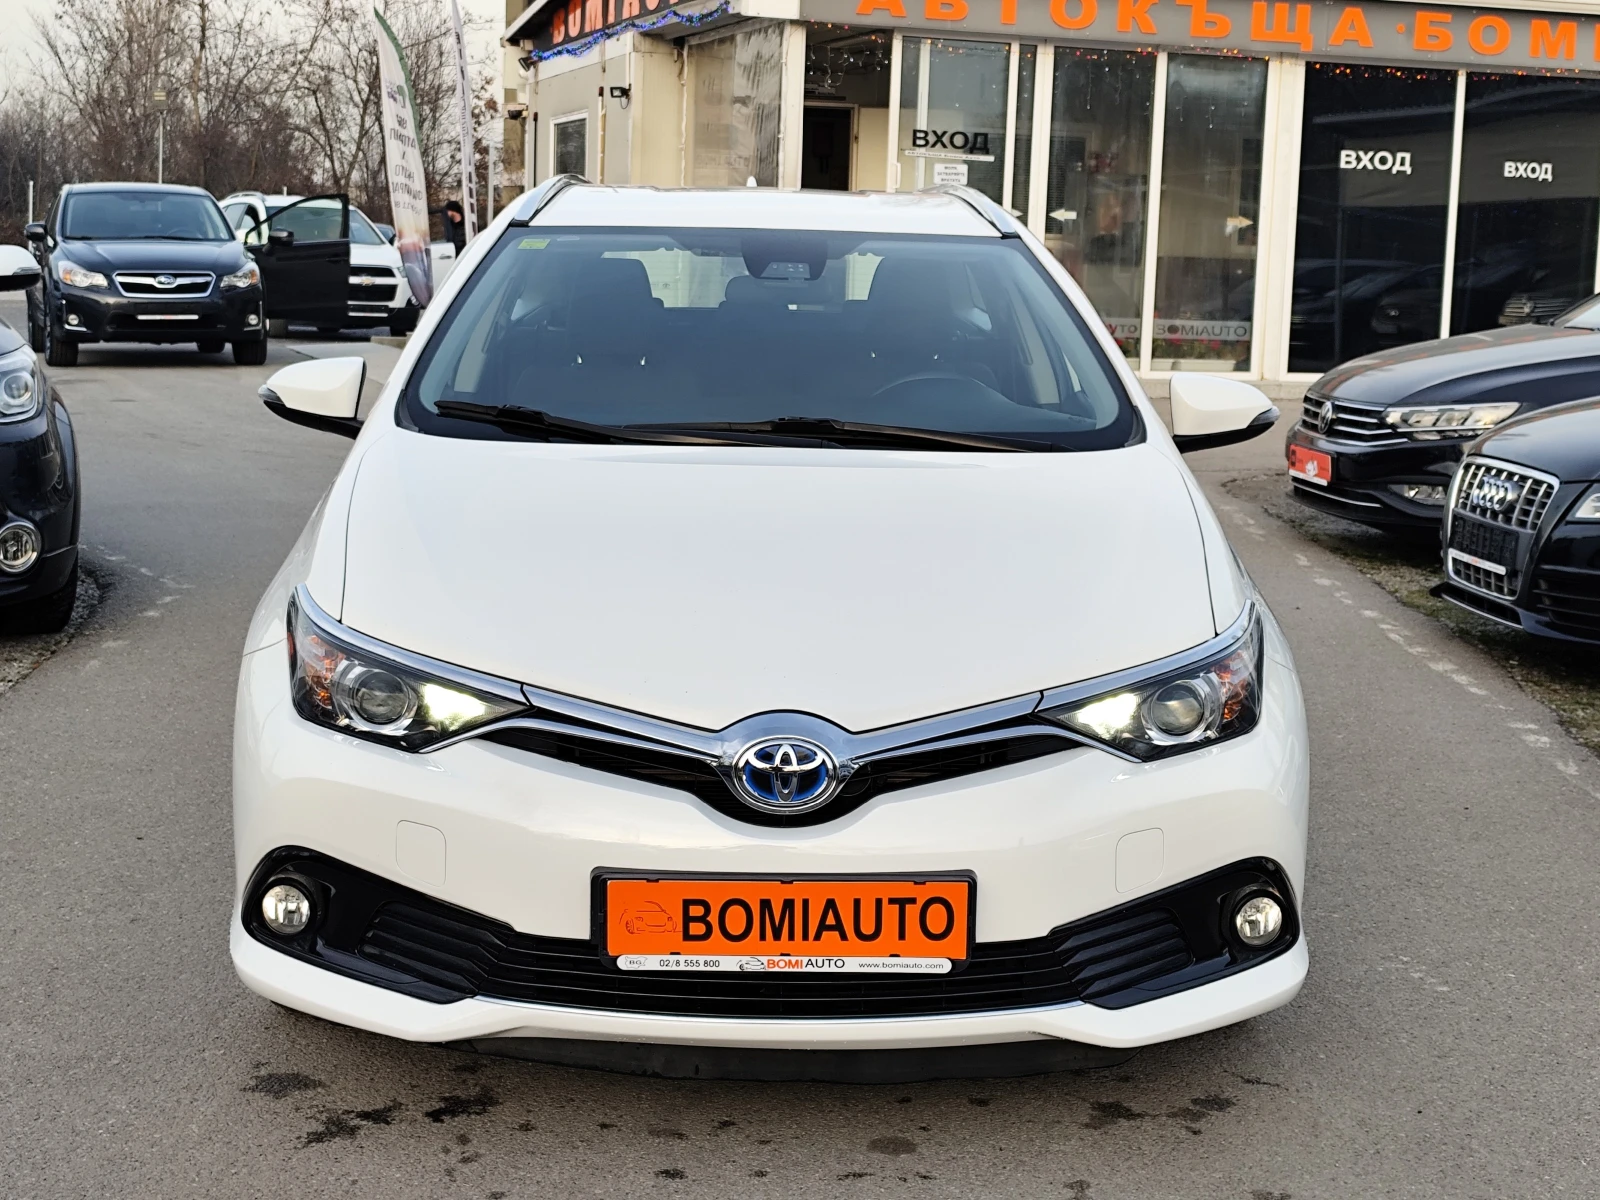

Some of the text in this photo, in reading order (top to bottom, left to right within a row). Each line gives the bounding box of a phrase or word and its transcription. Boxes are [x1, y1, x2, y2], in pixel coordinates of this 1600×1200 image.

[1413, 11, 1600, 62] БОМ
[912, 129, 990, 155] ВХОД
[1339, 149, 1412, 175] ВХОД
[1504, 161, 1553, 182] ВХОД
[682, 897, 955, 943] BOMIAUTO
[659, 959, 720, 967] 02/8 555 800
[858, 961, 944, 970] www.bomiauto.com
